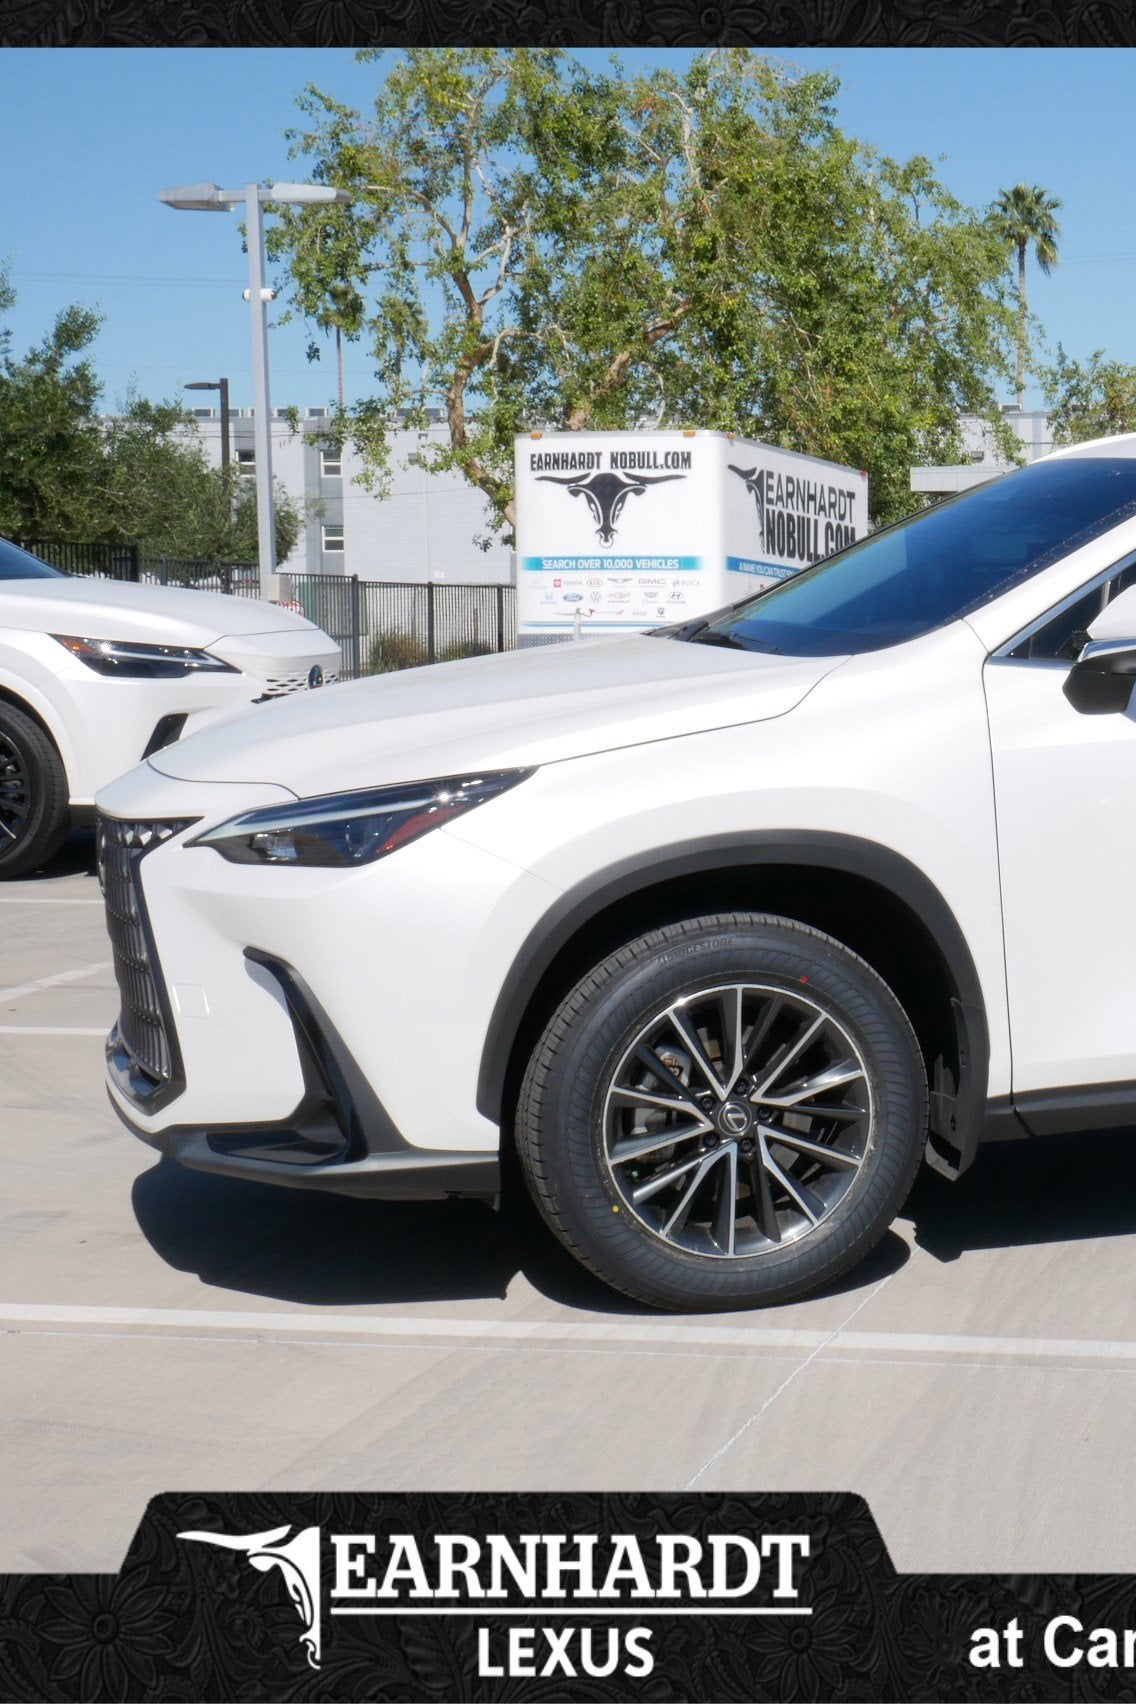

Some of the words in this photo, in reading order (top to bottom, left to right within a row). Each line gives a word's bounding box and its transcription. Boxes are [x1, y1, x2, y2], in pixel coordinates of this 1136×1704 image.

[530, 452, 601, 471] EARNHARDT
[610, 451, 692, 470] NOBULL.COM
[766, 469, 856, 523] EARNHARDT
[542, 559, 576, 569] SEARCH
[577, 559, 601, 569] OVER
[603, 559, 633, 570] 10,000
[635, 559, 679, 569] VEHICLES
